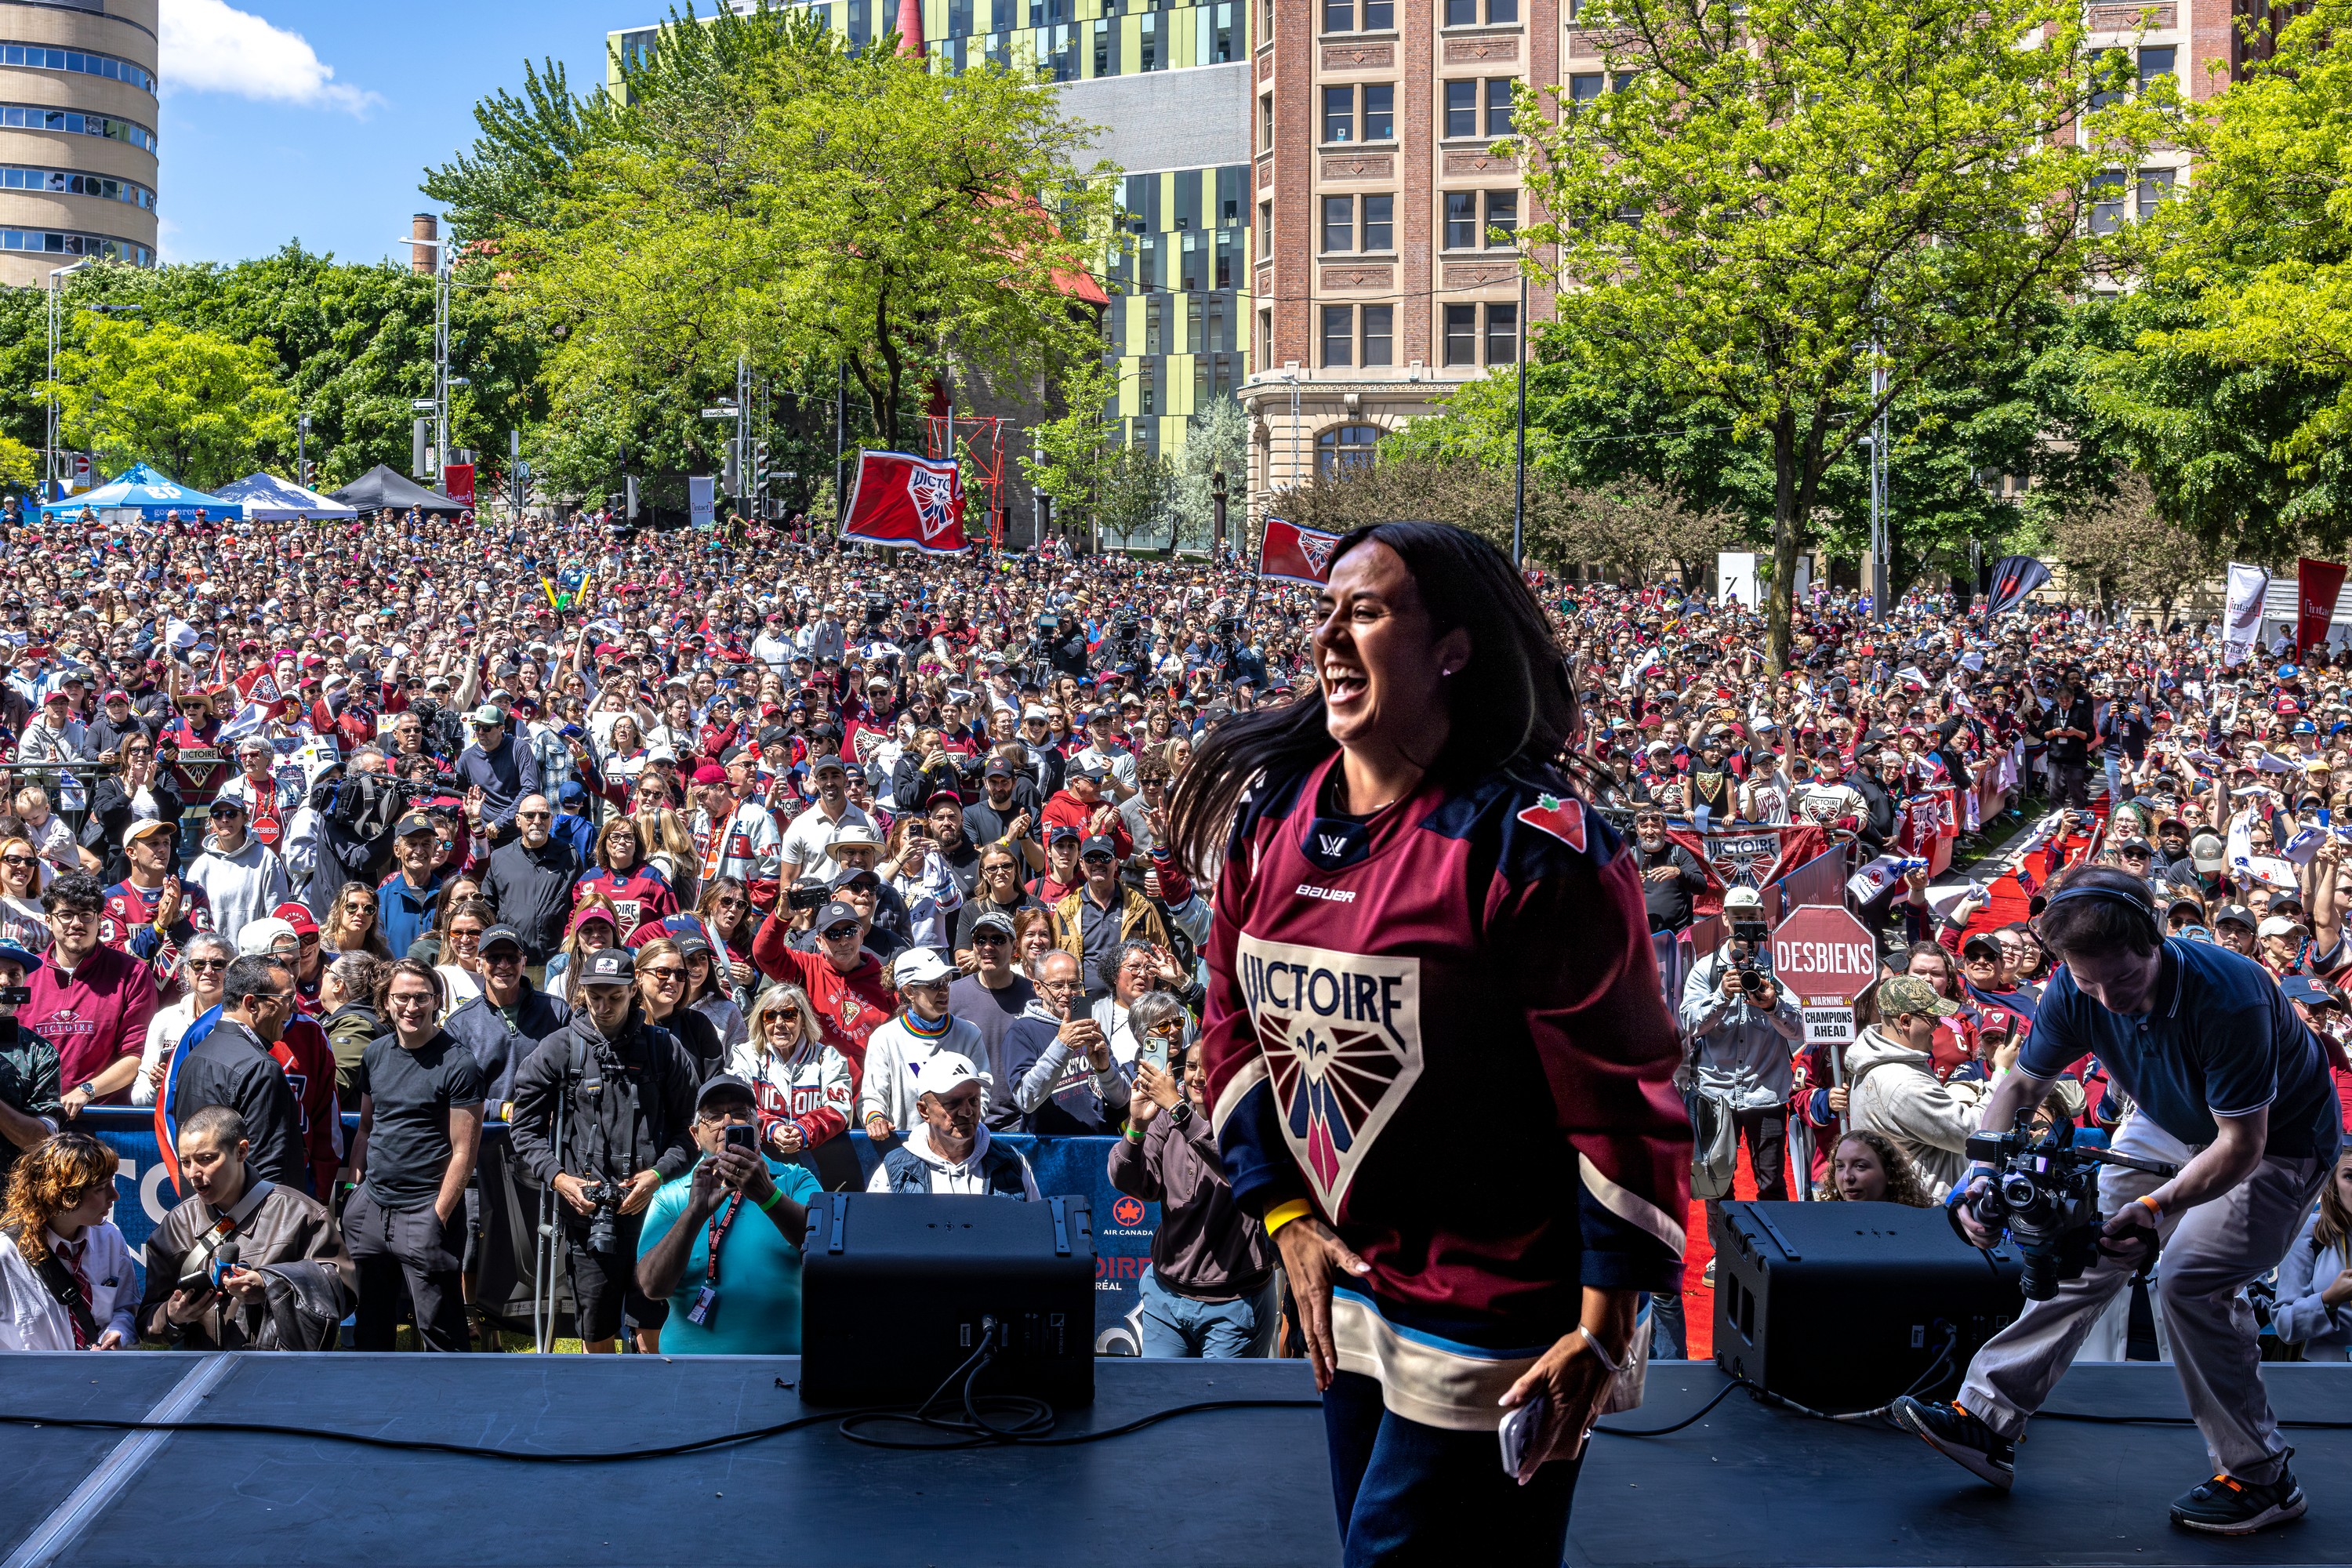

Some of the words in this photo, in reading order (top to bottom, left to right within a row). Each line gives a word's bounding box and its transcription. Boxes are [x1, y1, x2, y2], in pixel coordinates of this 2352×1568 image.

[265, 674, 278, 700] VICTOIRE
[521, 706, 532, 719] C
[181, 750, 216, 760] VICTOIRE
[949, 755, 967, 764] TOIRE
[1698, 774, 1722, 782] VICTOIRE
[1653, 787, 1682, 797] VIOIRE
[782, 801, 800, 811] TOIRE
[1809, 798, 1839, 809] VICTOIRE
[760, 843, 781, 857] MT
[1708, 837, 1777, 862] VICTOIRE
[1296, 884, 1356, 903] BAUER
[285, 912, 306, 921] NTREAL
[615, 904, 637, 920] OIRE
[1777, 941, 1873, 975] DESBIENS
[1243, 952, 1406, 1051] VICTOIRE
[1809, 996, 1843, 1006] WARNING
[1805, 1011, 1853, 1024] CHAMPIONS
[37, 1022, 93, 1033] VICTOIRE
[1814, 1025, 1846, 1037] AHEAD
[721, 1207, 735, 1227] ESPN
[711, 1228, 724, 1250] ESPN
[708, 1254, 717, 1277] ESPN
[1095, 1279, 1122, 1290] RÉAL
